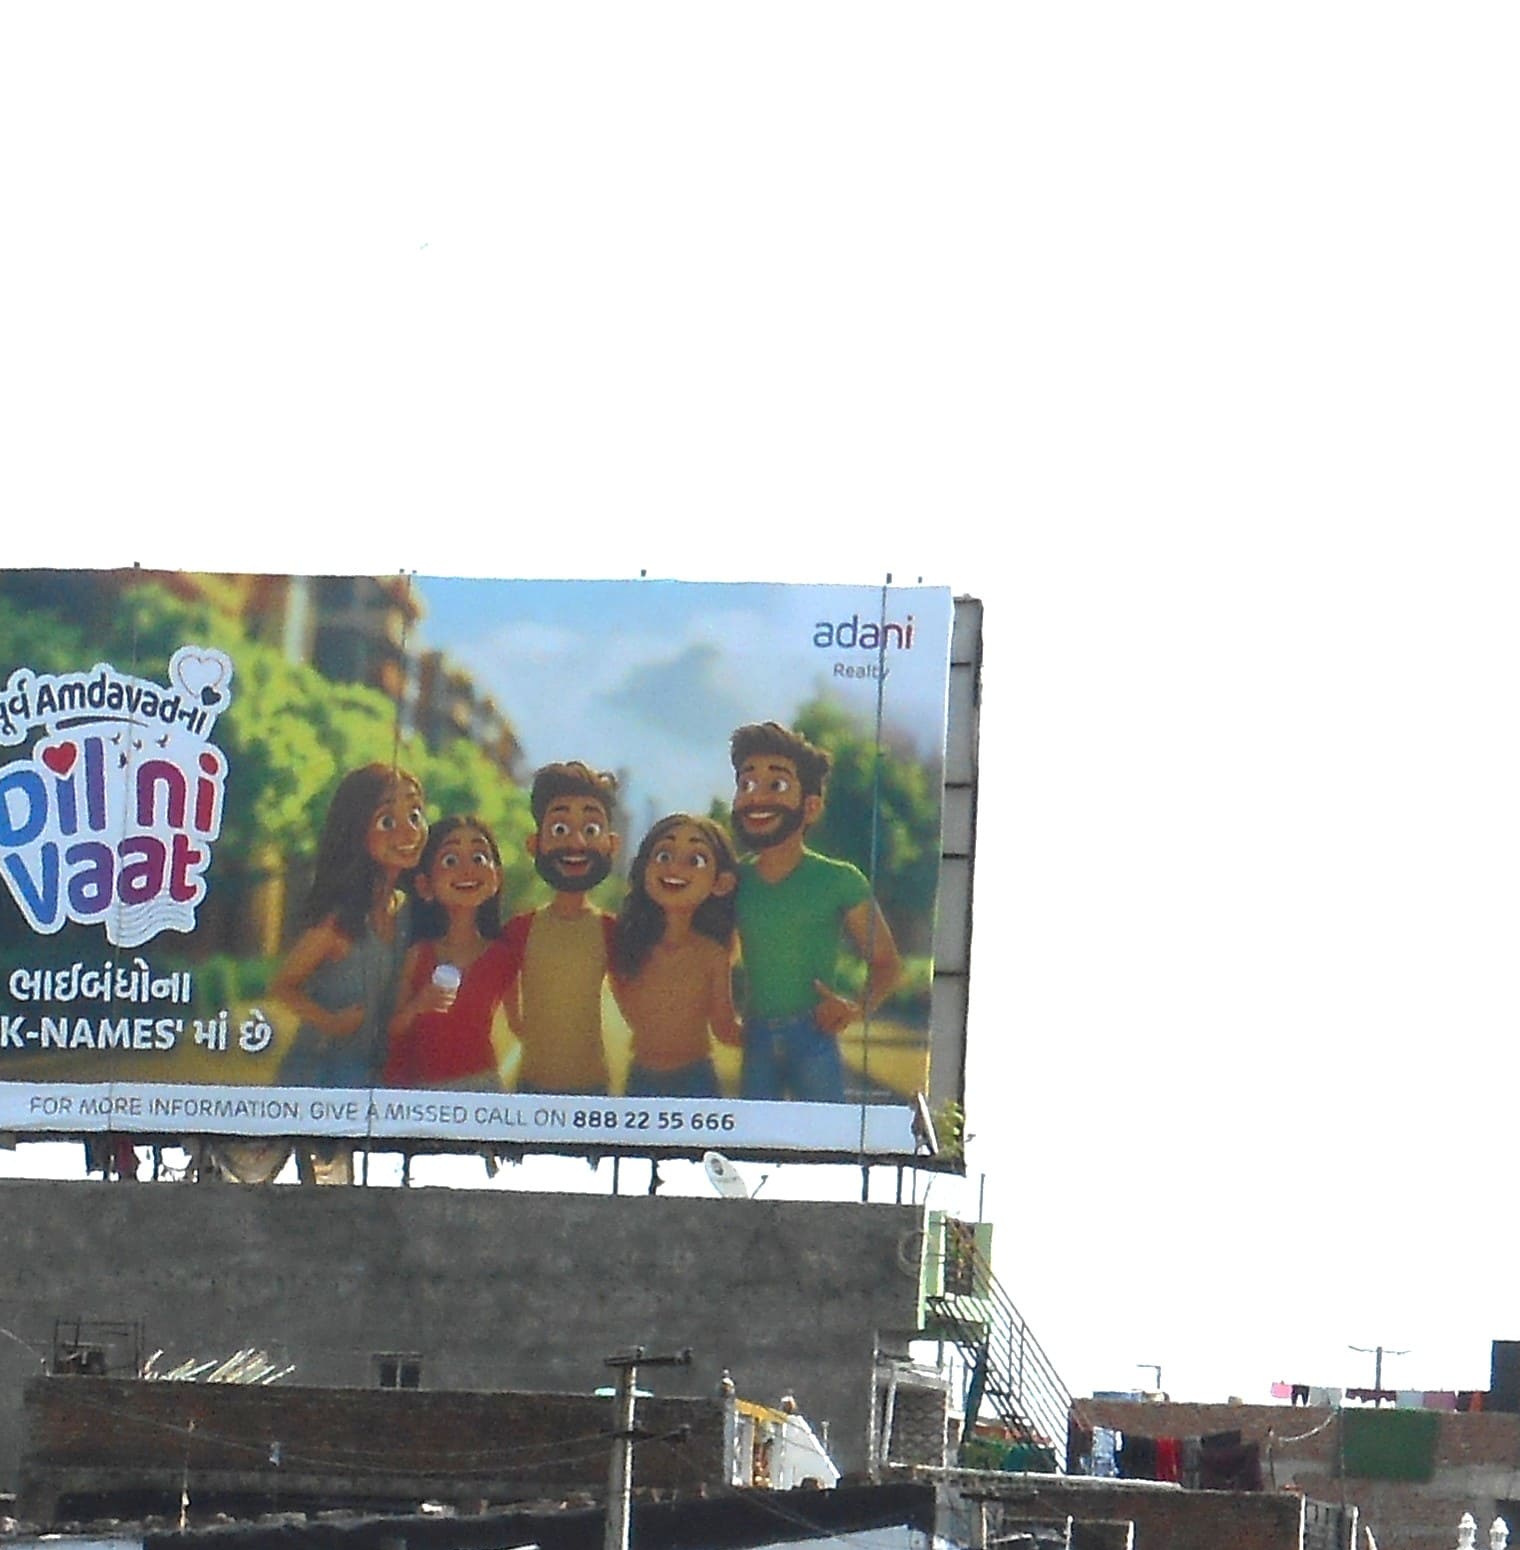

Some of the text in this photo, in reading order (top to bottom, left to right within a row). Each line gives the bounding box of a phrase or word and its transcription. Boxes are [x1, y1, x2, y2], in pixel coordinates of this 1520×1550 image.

[813, 614, 915, 650] adani
[136, 752, 220, 833] ni
[3, 833, 202, 925] Vaat
[239, 1008, 273, 1052] છે
[30, 1095, 72, 1115] FOR
[80, 1096, 142, 1117] MORE
[310, 1101, 357, 1121] GIVE
[366, 1103, 378, 1122] A
[384, 1103, 468, 1124] MISSED
[474, 1106, 528, 1126] CALL
[533, 1108, 567, 1127] ON
[572, 1110, 618, 1129] 888
[624, 1111, 650, 1130] 22
[657, 1111, 684, 1130] 55
[690, 1113, 736, 1132] 666
